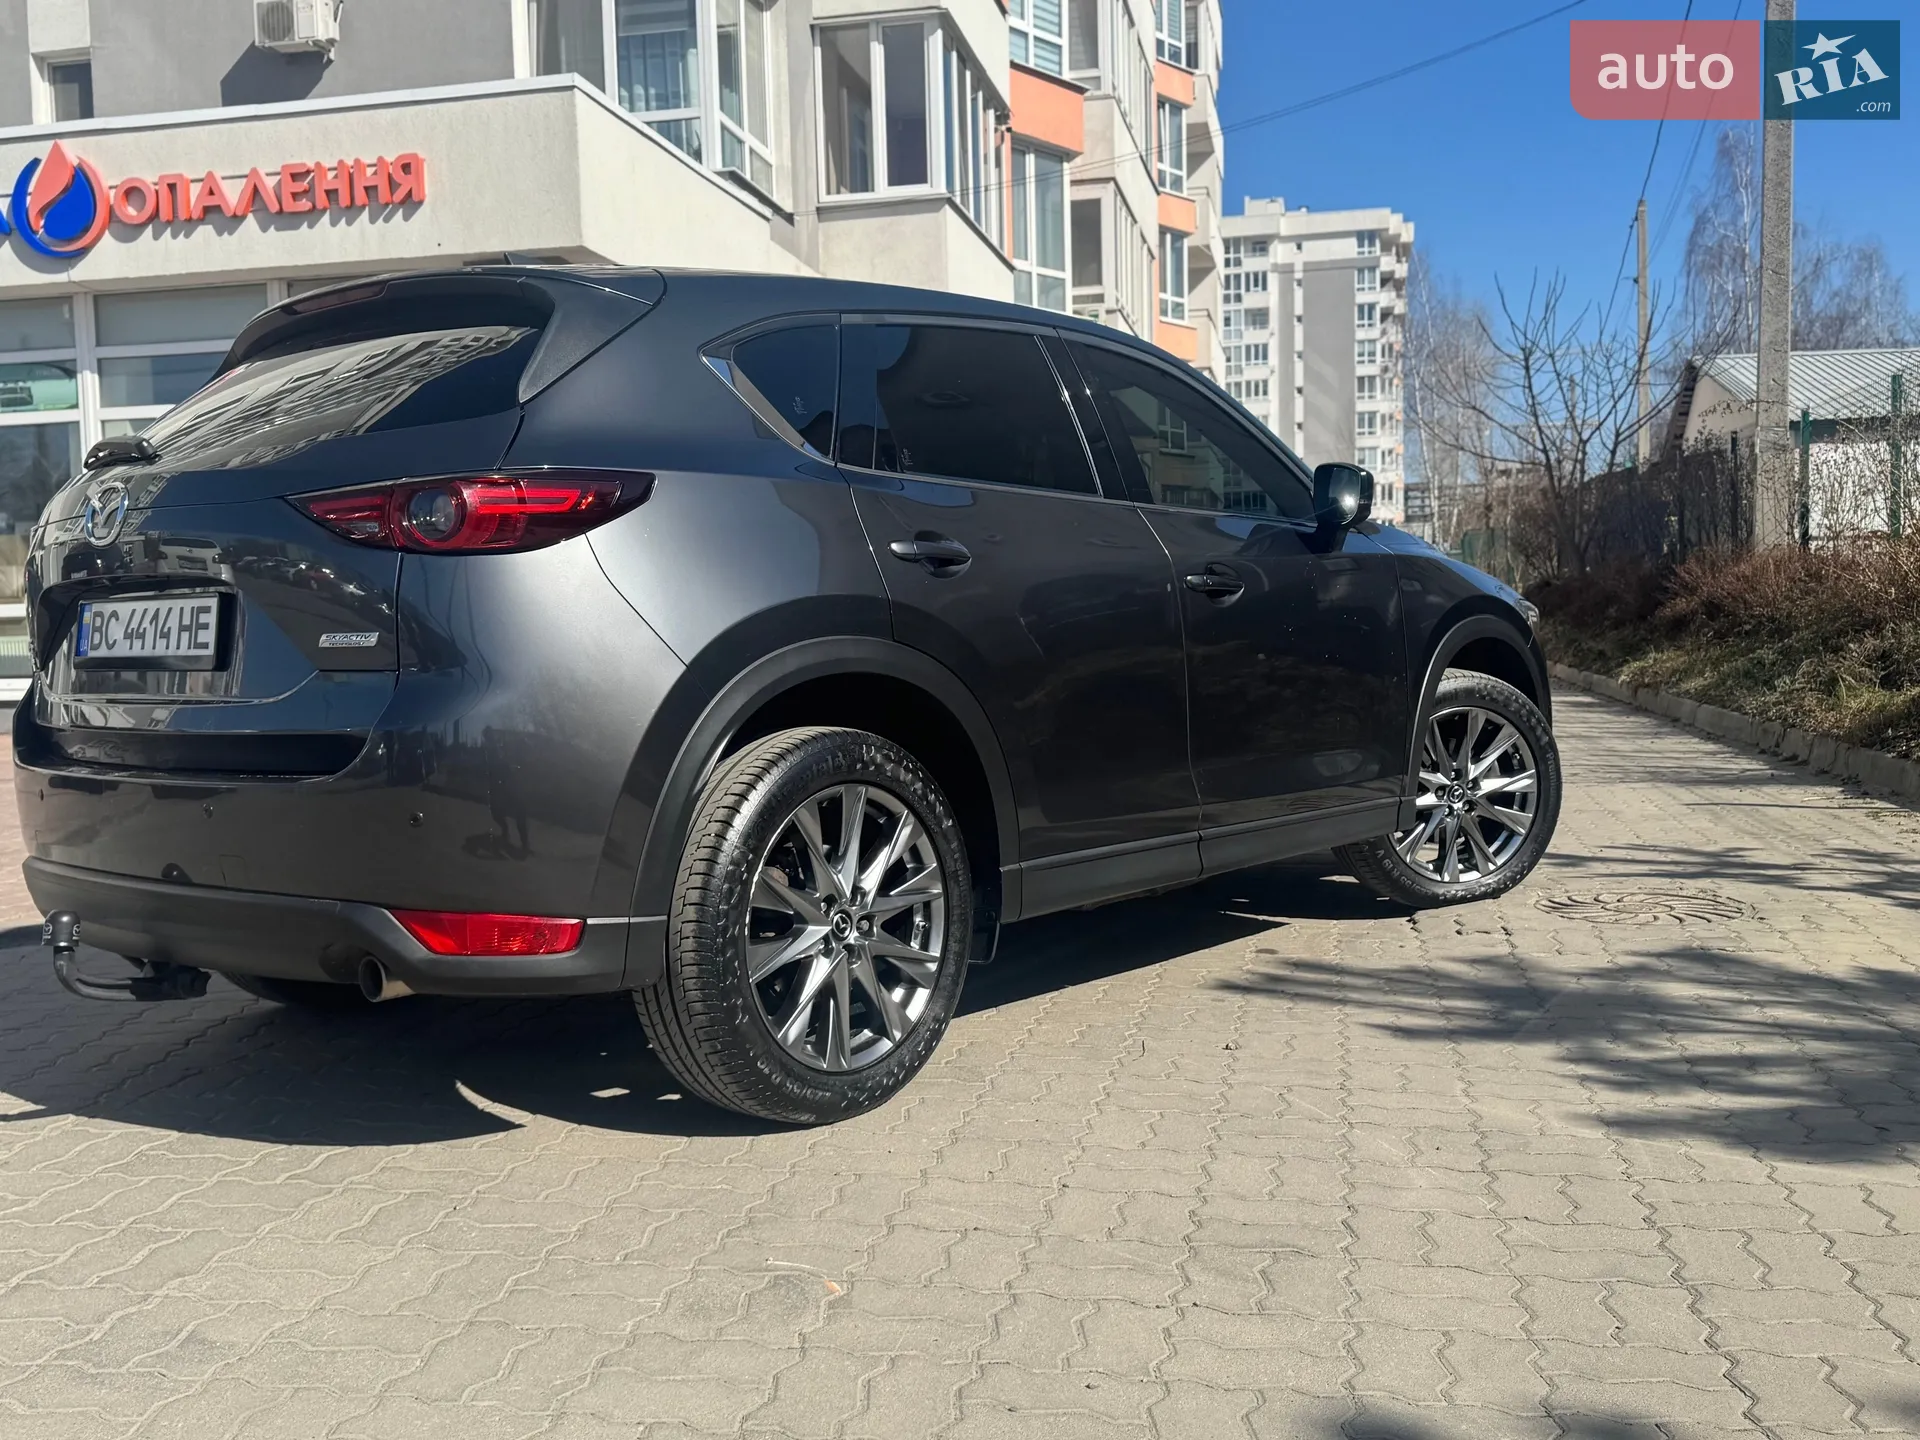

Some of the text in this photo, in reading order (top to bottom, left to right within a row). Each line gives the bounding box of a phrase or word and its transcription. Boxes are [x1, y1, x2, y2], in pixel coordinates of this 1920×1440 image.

[112, 153, 427, 226] ОПАЛЕННЯ
[122, 606, 173, 651] 4414
[325, 633, 372, 641] SKYACTIV
